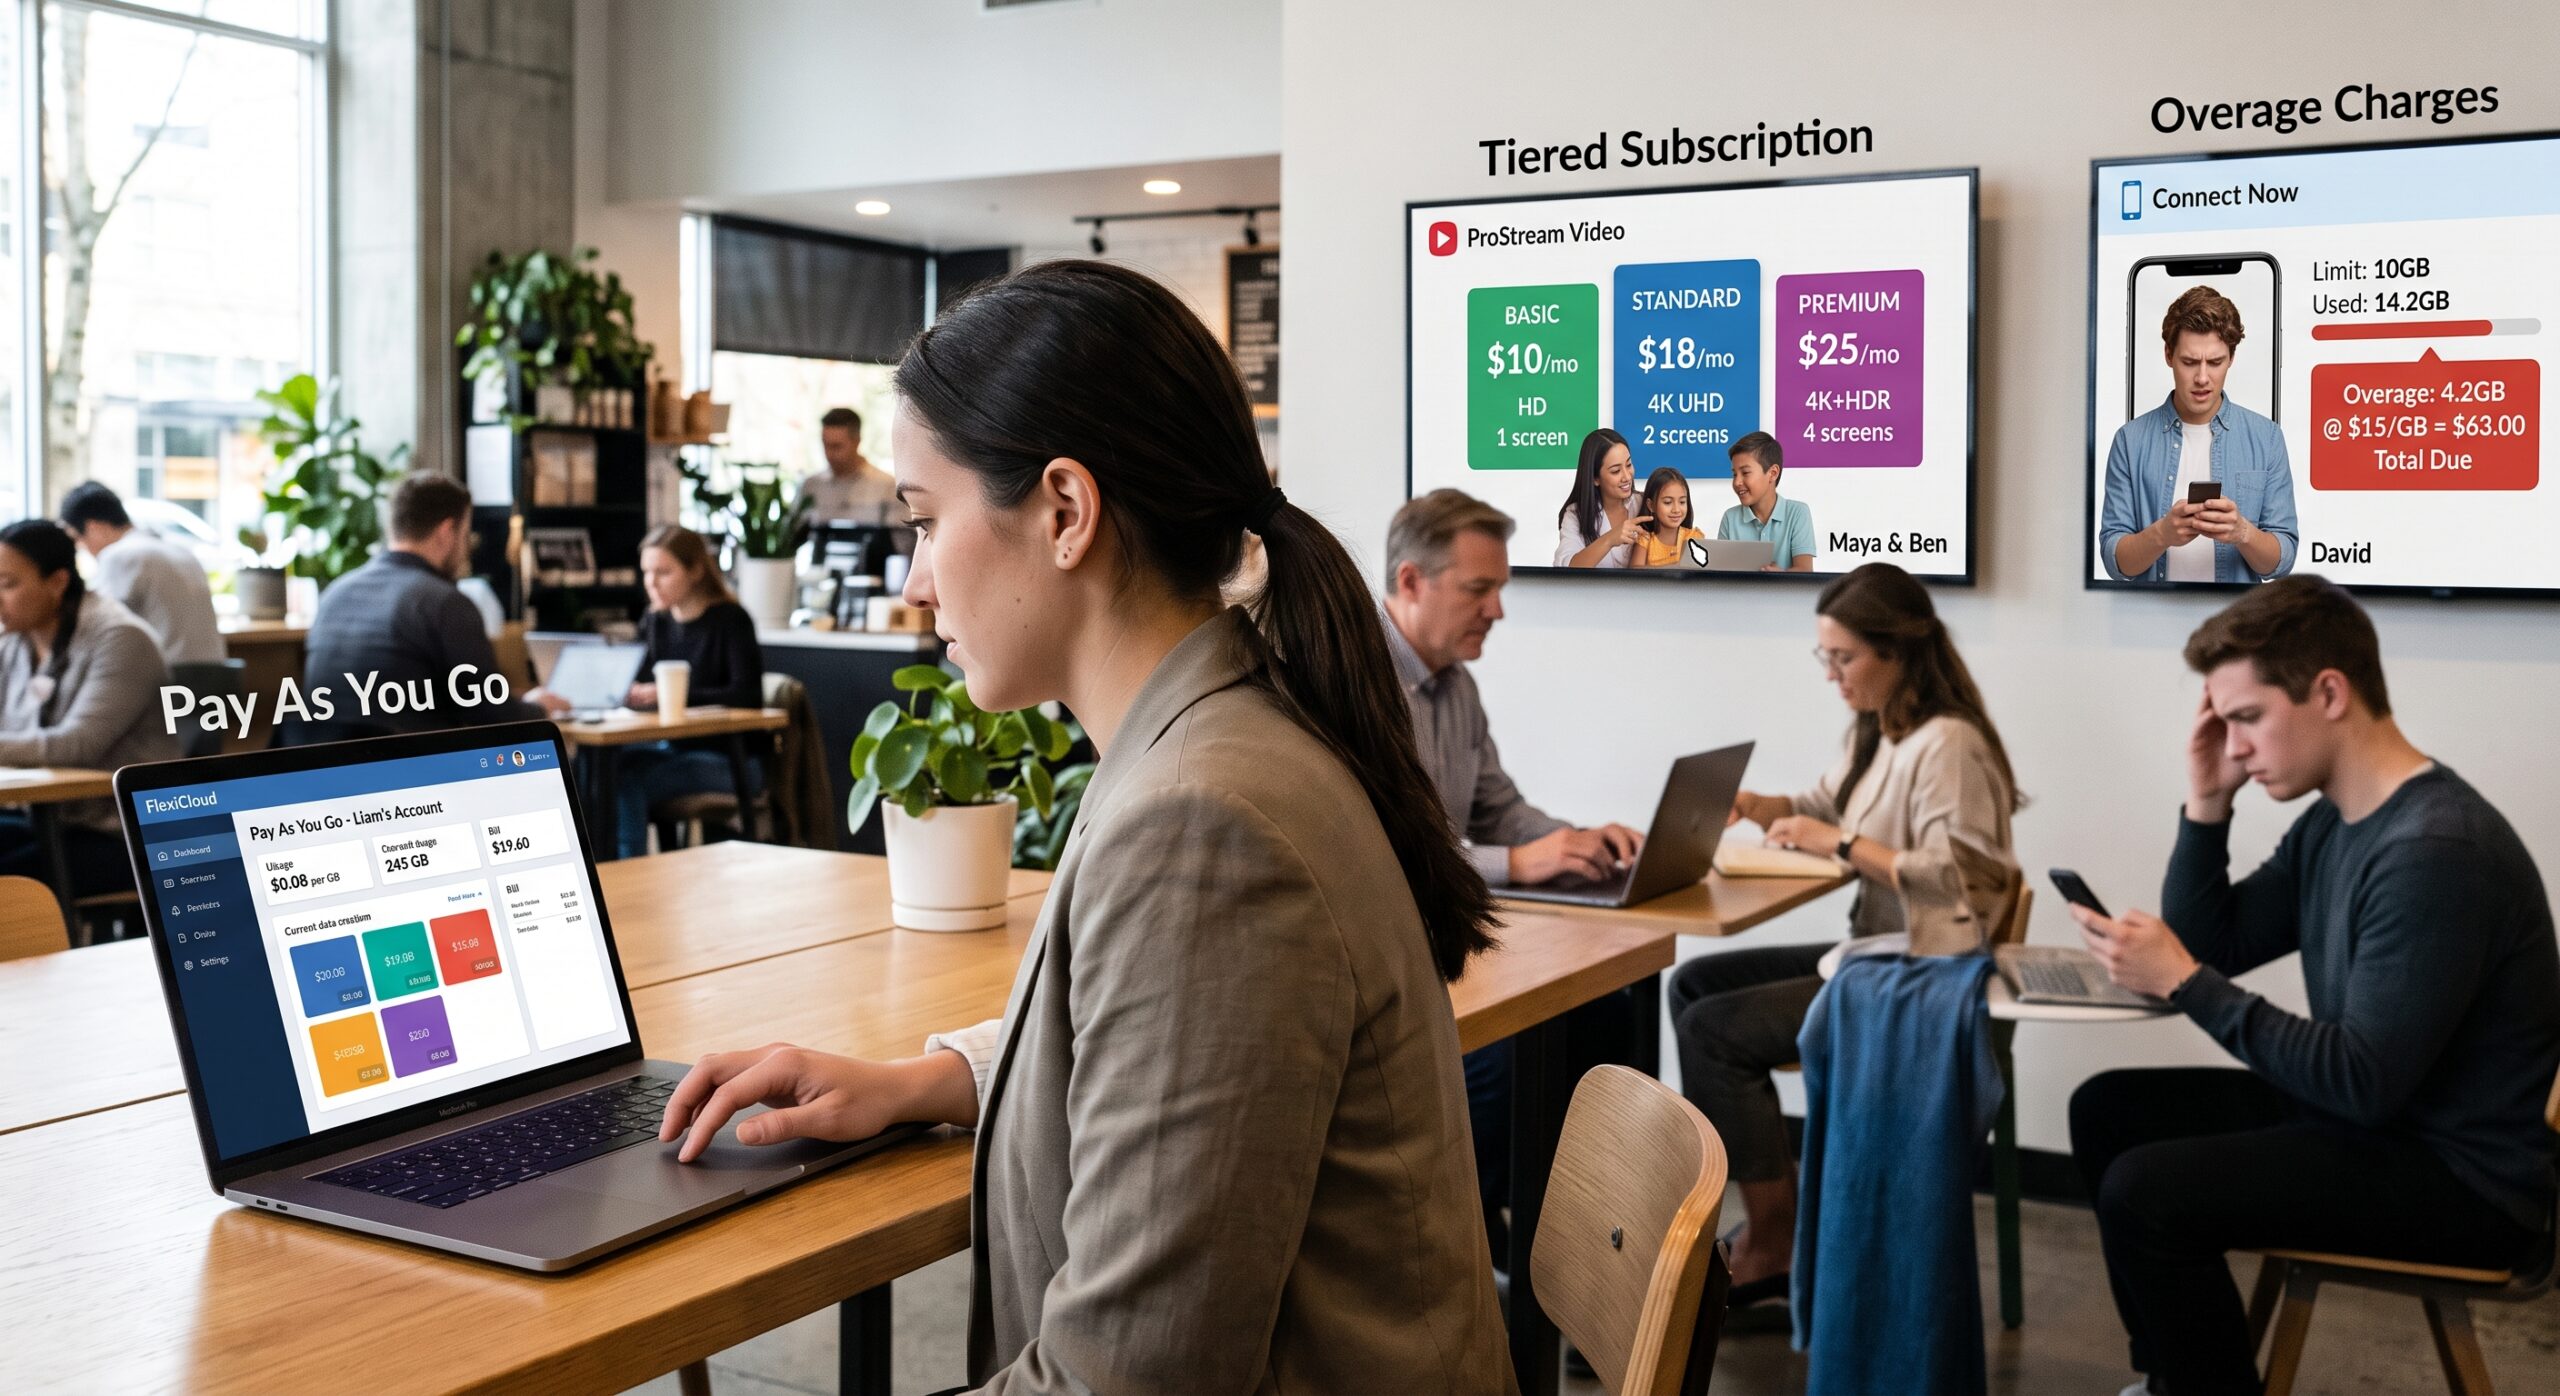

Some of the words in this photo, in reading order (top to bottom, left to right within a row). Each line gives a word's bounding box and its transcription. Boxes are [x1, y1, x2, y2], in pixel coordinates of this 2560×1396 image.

[2151, 96, 2322, 134] Overage
[2334, 83, 2499, 125] Charges
[1479, 132, 1607, 176] Tiered
[1620, 118, 1874, 167] Subscription
[2152, 185, 2242, 209] Connect
[2248, 182, 2299, 204] Now
[1467, 225, 1565, 248] ProStream
[1569, 221, 1626, 243] Video
[2313, 260, 2367, 282] Limit:
[2374, 257, 2431, 280] 10GB
[1632, 288, 1741, 310] STANDARD
[1798, 291, 1900, 315] PREMIUM
[2312, 294, 2368, 315] Used:
[2375, 290, 2450, 313] 14.2GB
[1505, 305, 1560, 325] BASIC
[1487, 341, 1579, 379] $10/mo
[1638, 336, 1735, 373] $18/mo
[1798, 331, 1900, 370] $25/mo
[1647, 395, 1674, 414] 4K
[1679, 393, 1724, 413] UHD
[1805, 390, 1891, 412] 4K+HDR
[2343, 383, 2435, 408] Overage:
[2440, 381, 2506, 403] 4.2GB
[1518, 397, 1547, 417] HD
[1497, 429, 1507, 447] 1
[1512, 430, 1568, 447] screen
[1643, 427, 1655, 445] 2
[1660, 427, 1729, 445] screens
[1803, 425, 1816, 443] 4
[1821, 426, 1894, 444] screens
[2323, 419, 2342, 440] @
[2348, 415, 2428, 440] $15/GB
[2434, 423, 2446, 432] =
[2452, 414, 2526, 439] $63.00
[2374, 449, 2424, 470] Total
[2429, 449, 2472, 470] Due
[1830, 532, 1882, 557] Maya
[1888, 533, 1903, 553] &
[1909, 532, 1947, 553] Ben
[2311, 542, 2372, 564] David
[159, 685, 258, 740] Pay
[272, 676, 335, 726] As
[343, 670, 436, 717] You
[447, 663, 510, 708] Go
[145, 791, 218, 814] FlexiCloud
[250, 826, 275, 842] Pay
[278, 822, 295, 837] As
[296, 818, 322, 834] You
[324, 815, 343, 829] Go
[352, 807, 392, 825] Liam's
[394, 800, 444, 819] Account
[492, 836, 530, 855] $19.60
[385, 857, 409, 873] 245
[410, 853, 430, 868] GB
[270, 873, 309, 893] $0.08
[311, 875, 325, 887] per
[326, 872, 340, 883] GB
[318, 920, 337, 930] data
